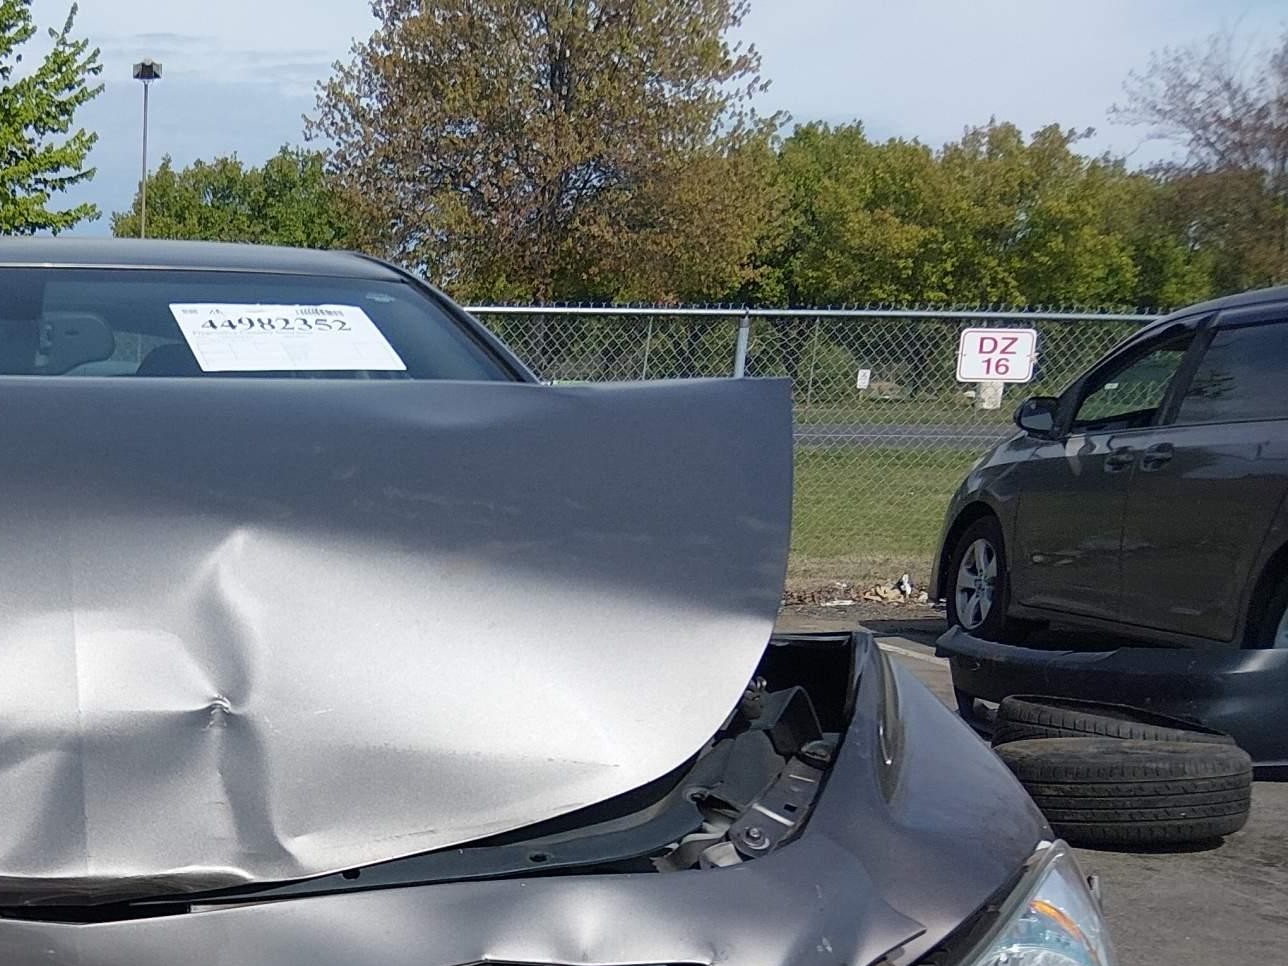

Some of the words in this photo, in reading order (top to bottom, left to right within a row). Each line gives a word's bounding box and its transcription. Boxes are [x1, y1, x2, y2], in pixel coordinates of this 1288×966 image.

[201, 316, 352, 332] 44982352
[978, 336, 1019, 355] DZ
[981, 357, 1010, 375] 16
